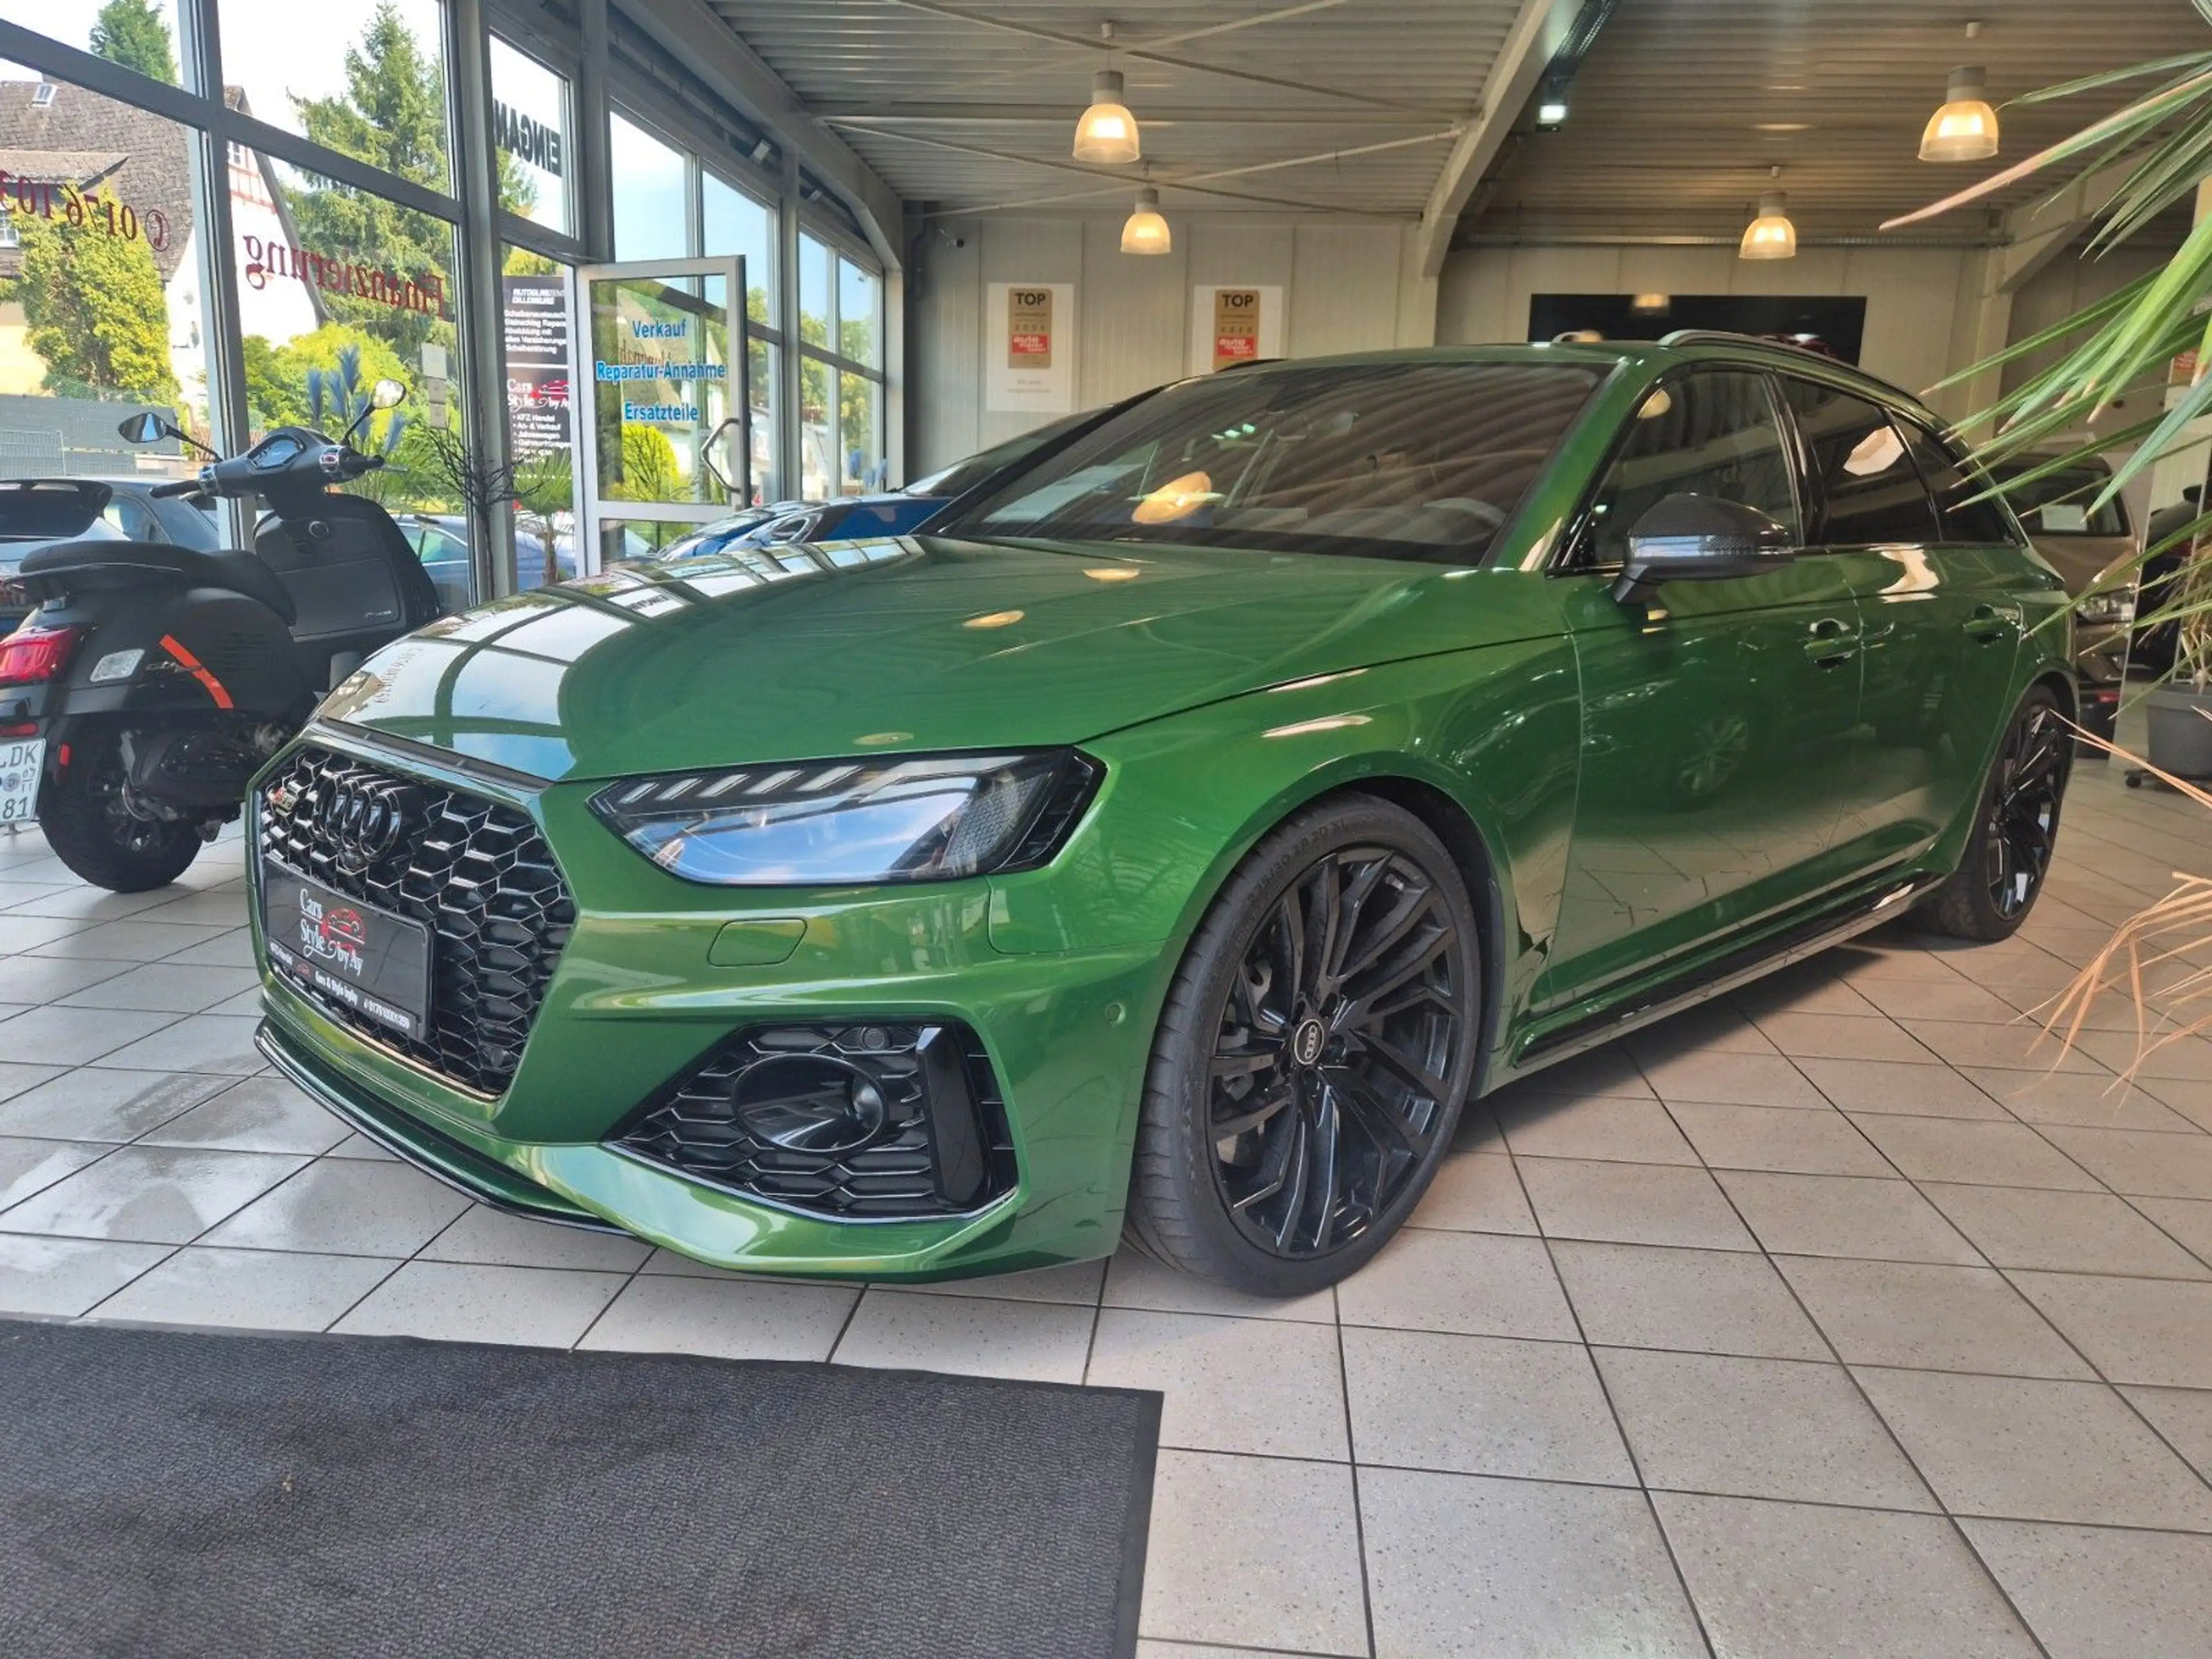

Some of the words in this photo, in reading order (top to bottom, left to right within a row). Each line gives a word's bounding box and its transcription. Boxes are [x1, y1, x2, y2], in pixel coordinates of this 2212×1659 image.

[1014, 292, 1046, 305] TOP
[1222, 294, 1254, 307] TOP
[632, 319, 687, 338] Verkauf
[596, 361, 725, 383] Reparatur-Annahme
[624, 403, 698, 421] Ersatzteile
[2, 796, 29, 820] 81
[300, 888, 323, 920] Cars
